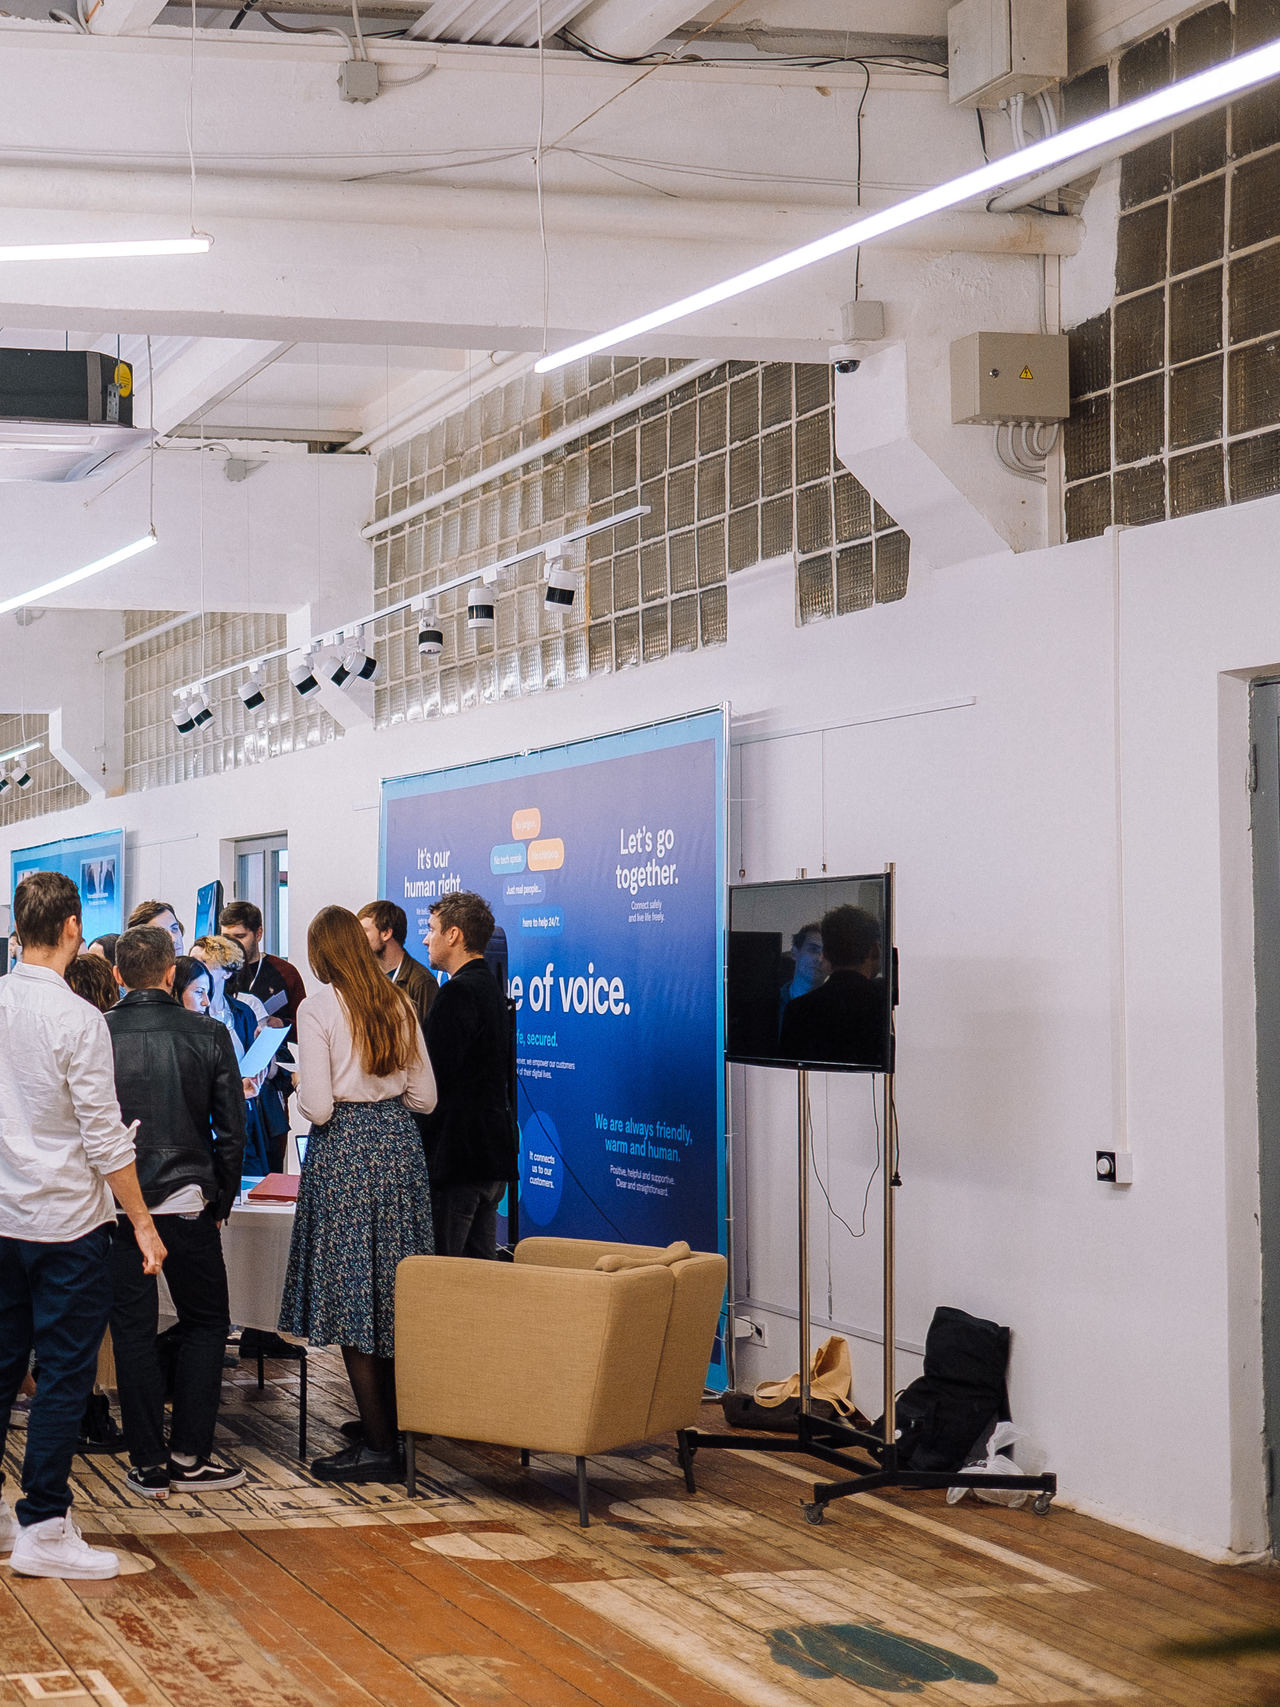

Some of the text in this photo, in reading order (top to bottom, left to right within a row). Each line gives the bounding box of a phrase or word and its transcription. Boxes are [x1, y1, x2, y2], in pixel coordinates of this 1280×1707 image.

[620, 825, 674, 858] Let's go
[417, 848, 450, 870] It's our
[615, 858, 678, 895] together.
[404, 876, 435, 898] human
[506, 885, 515, 895] Just
[631, 899, 662, 911] Connect safely
[522, 917, 532, 928] here
[533, 917, 538, 927] to
[538, 916, 548, 929] help
[628, 913, 636, 922] and
[529, 962, 554, 1012] of
[559, 962, 631, 1016] voice.
[527, 1031, 558, 1047] secured.
[594, 1112, 693, 1146] We are always friendly,
[604, 1138, 681, 1162] warm and human.
[533, 1153, 555, 1165] connects
[531, 1165, 552, 1176] us to our
[627, 1167, 642, 1179] helpful
[642, 1172, 650, 1181] and
[615, 1177, 626, 1188] Clear
[627, 1181, 636, 1191] and
